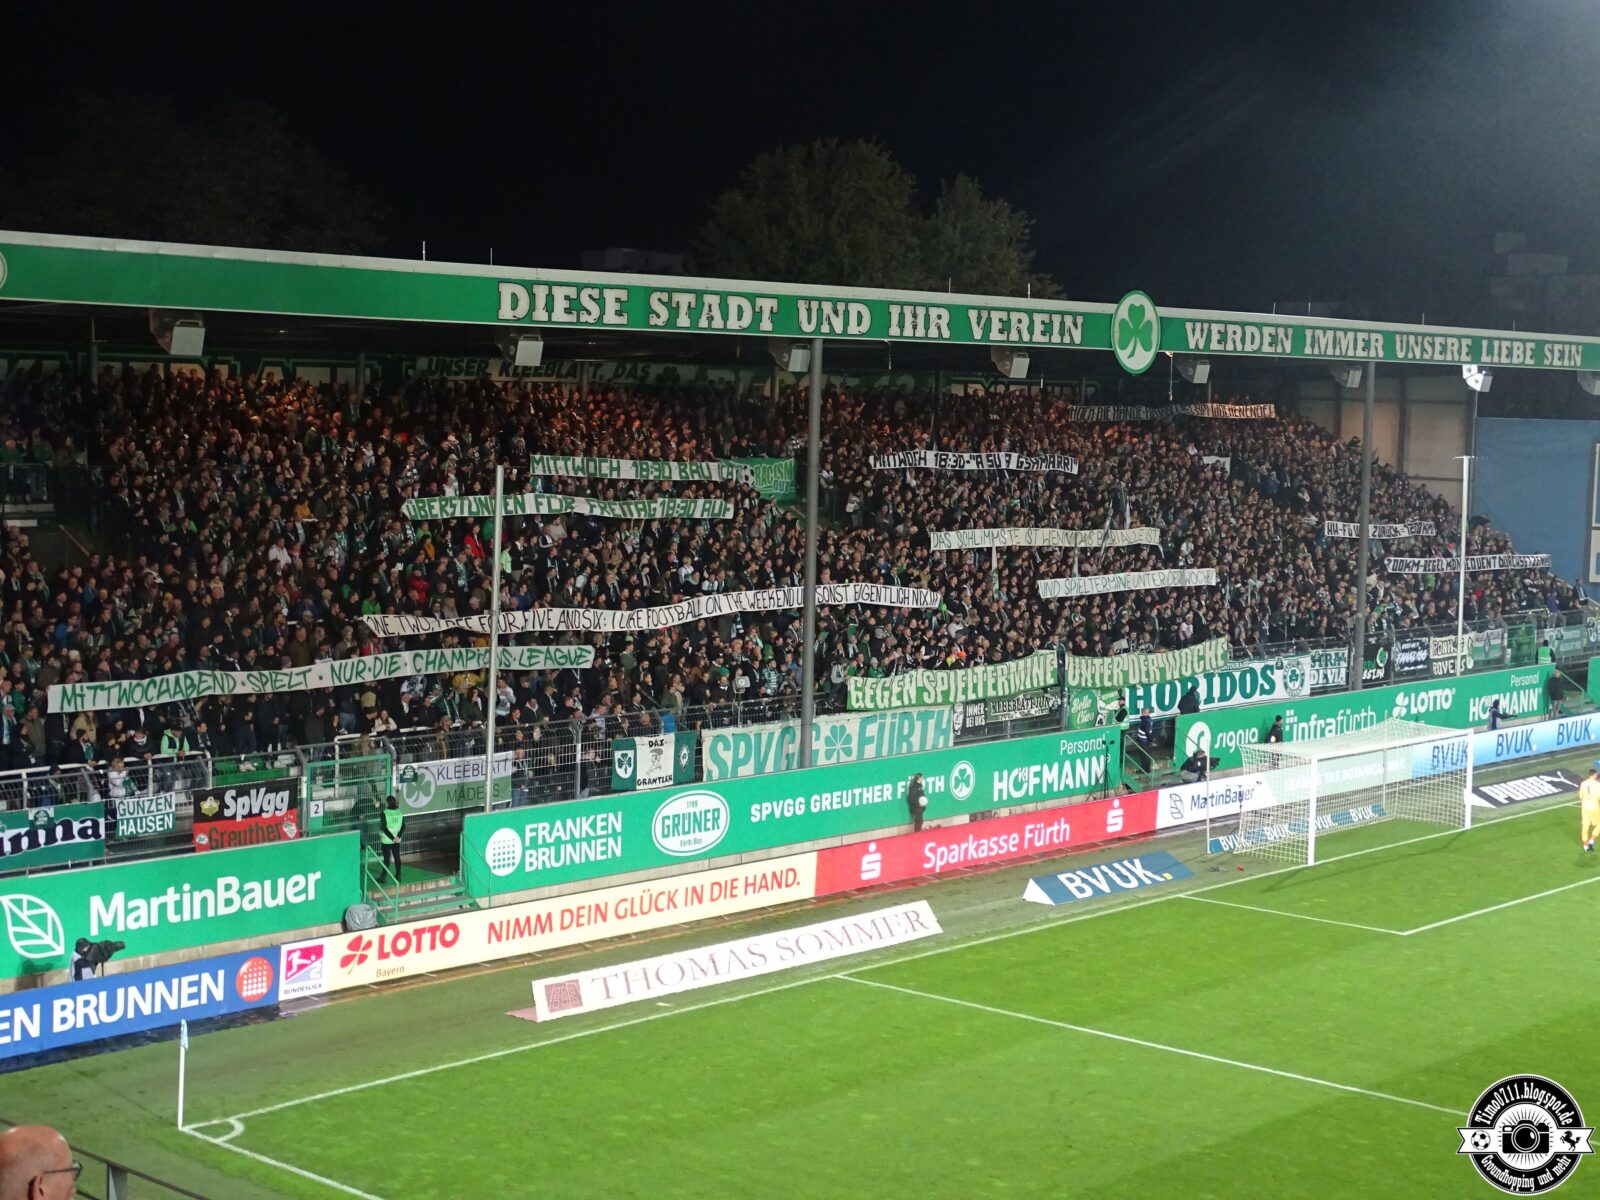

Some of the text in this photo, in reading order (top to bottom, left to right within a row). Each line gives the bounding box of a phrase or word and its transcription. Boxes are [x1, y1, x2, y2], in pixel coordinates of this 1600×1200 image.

[498, 281, 1583, 367] DIESE STADT UND IHR VEREIN WERDEN IMMER UNSERE LIEBE SEIN
[531, 455, 621, 477] MITTWOCH
[632, 459, 671, 480] 18:30
[680, 461, 712, 480] BAU
[754, 458, 794, 488] RACISM
[872, 451, 928, 468] MITTWOCH
[773, 480, 791, 493] OUT
[700, 499, 733, 519] AUF
[932, 531, 952, 549] DAS
[556, 609, 581, 630] AND
[647, 600, 703, 628] FOOTBALL
[706, 597, 722, 615] ON
[723, 593, 747, 611] THE
[747, 588, 794, 609] WEEKEND
[816, 585, 850, 604] SONST
[854, 584, 909, 605] EIGENTLICH
[330, 661, 367, 685] NUR
[373, 655, 401, 678] DIE
[518, 647, 591, 668] LEAGUE
[850, 641, 1229, 708] GEGEN SPIELTERMINE UNTER DER WOCHE
[1510, 675, 1539, 688] Personal
[966, 703, 984, 717] IMMER
[1410, 688, 1453, 714] LOTTO
[857, 706, 953, 762] FÜRTH
[1292, 706, 1377, 742] infrafürth
[1060, 733, 1106, 756] Personal
[1214, 727, 1258, 754] signia
[993, 755, 1105, 803] HOFMANN
[117, 796, 172, 817] GUNZEN
[223, 788, 289, 822] SpVgg
[313, 804, 320, 814] 2
[750, 796, 806, 824] SPVGG
[810, 786, 893, 812] GREUTHER
[1190, 787, 1256, 812] MartinBauer
[118, 814, 173, 836] HAUSEN
[208, 822, 282, 850] Greuther
[524, 811, 622, 846] FRANKEN
[661, 808, 720, 839] GRÜNER
[524, 836, 622, 873] BRUNNEN
[924, 817, 1070, 873] Sparkasse Fürth
[89, 870, 320, 937] MartinBauer
[487, 868, 801, 946] NIMM DEIN GLÜCK IN DIE HAND.
[377, 922, 460, 962] LOTTO
[591, 909, 931, 1001] THOMAS SOMMER
[375, 965, 405, 977] Bayern
[52, 969, 225, 1034] BRUNNEN
[284, 983, 322, 995] BUNDESLIGA
